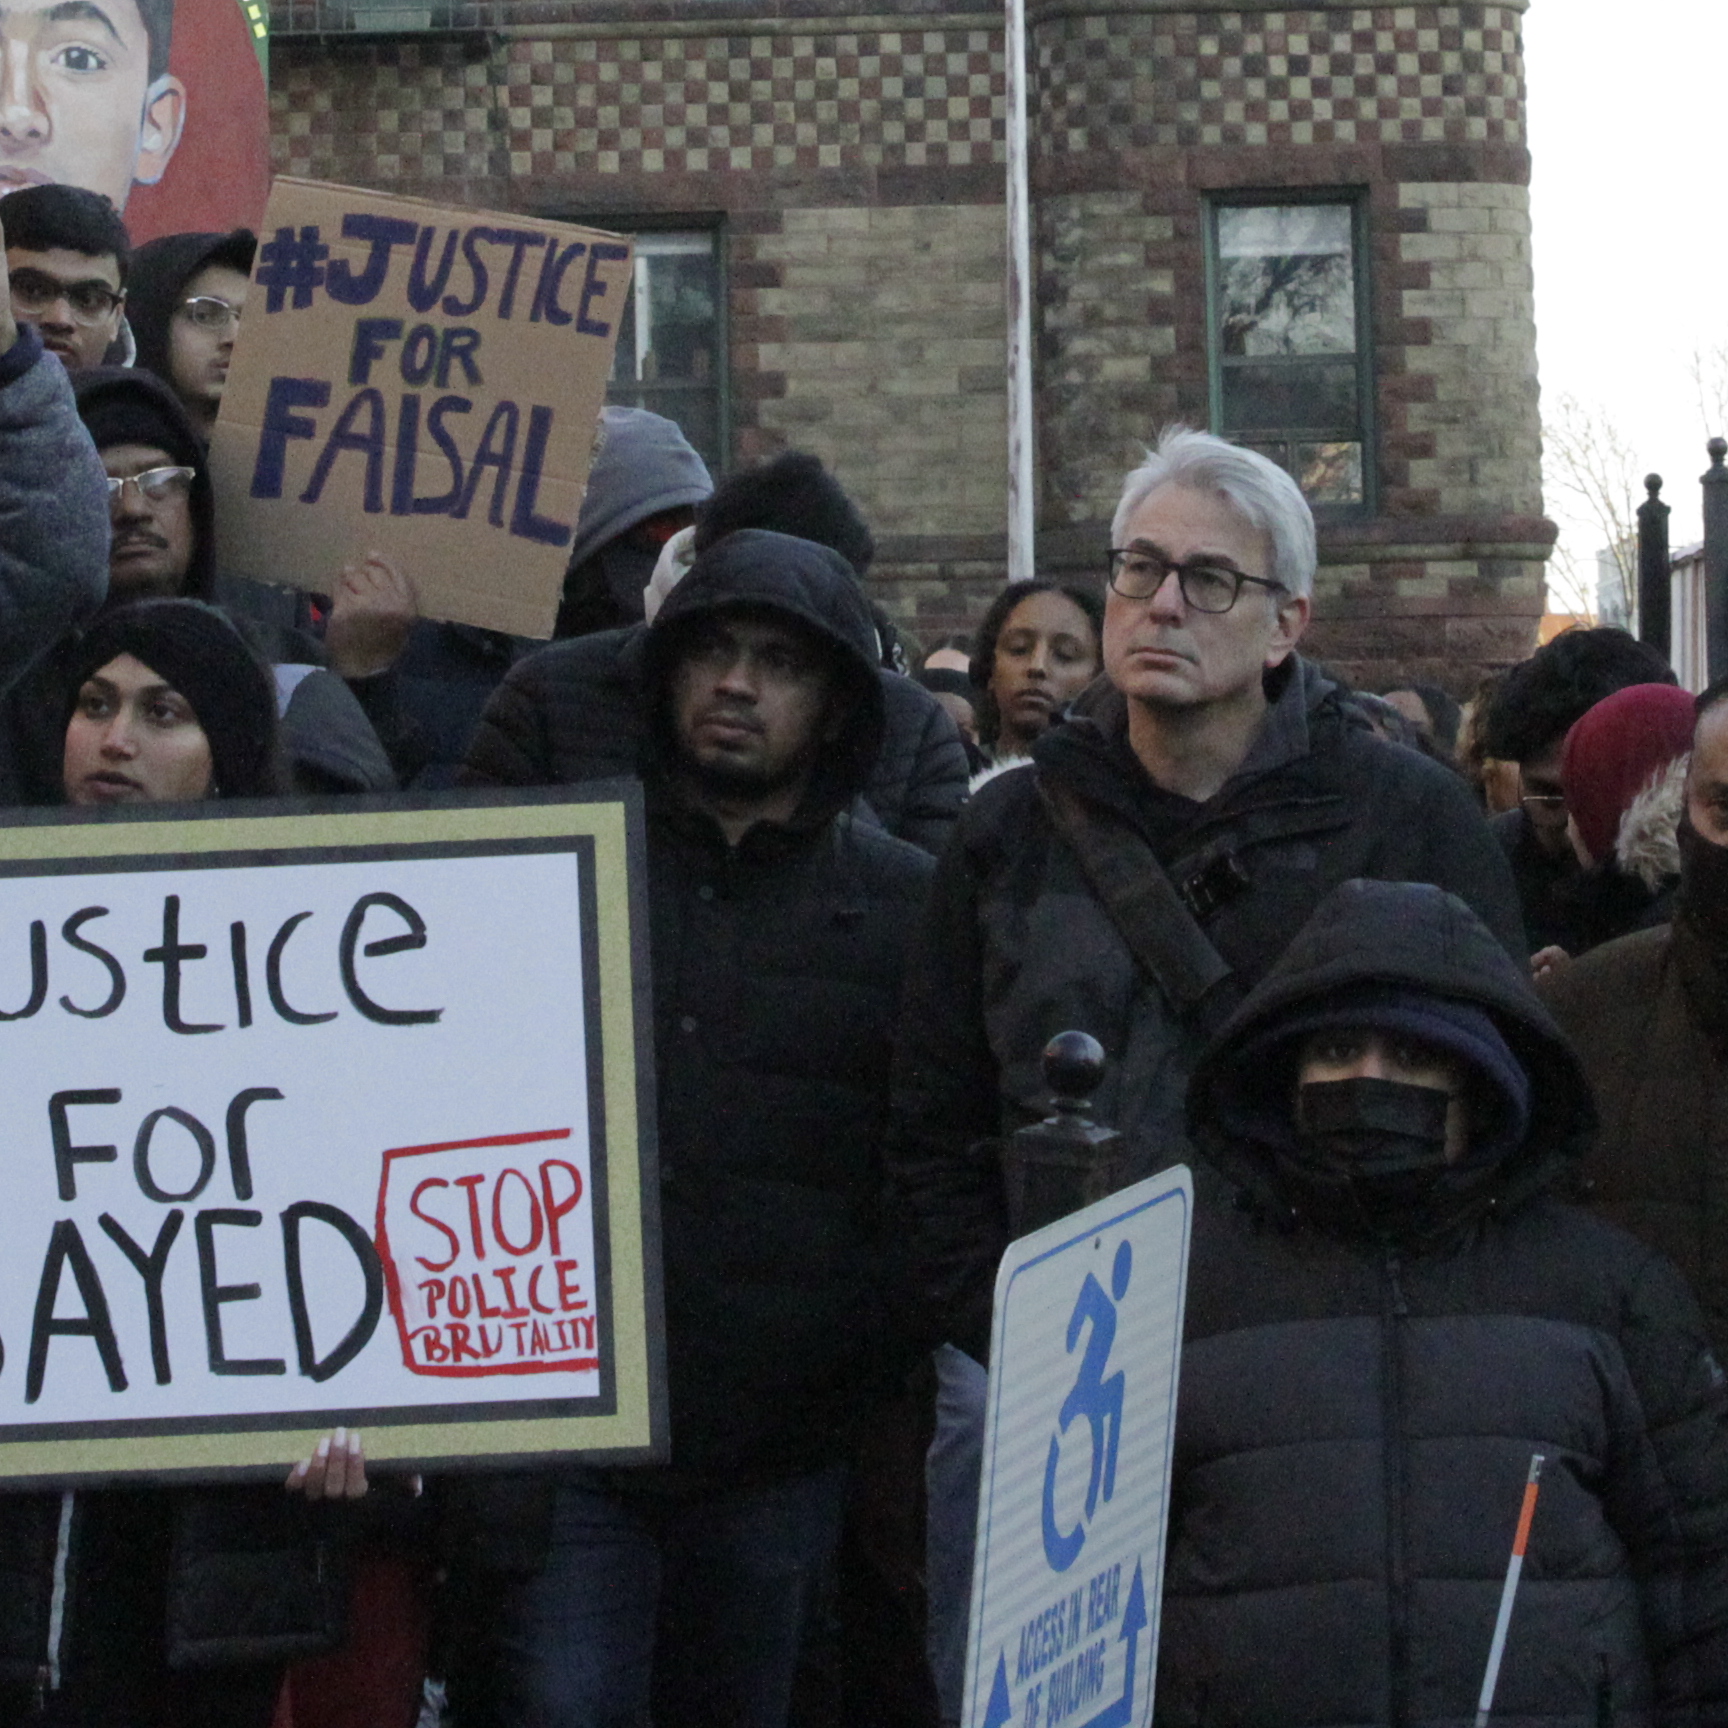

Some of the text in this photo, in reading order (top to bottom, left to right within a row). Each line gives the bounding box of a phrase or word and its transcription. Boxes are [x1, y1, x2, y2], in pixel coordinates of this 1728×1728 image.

[255, 213, 628, 337] #JUSTICE
[348, 317, 483, 388] FOR
[250, 376, 571, 547] FAISAL
[410, 1159, 582, 1272] STOP
[409, 1315, 595, 1363] BRUTALITY
[418, 1260, 588, 1319] POLICE
[1015, 1562, 1120, 1687] ACCESS IN REAR
[1046, 1637, 1106, 1728] BUILDING
